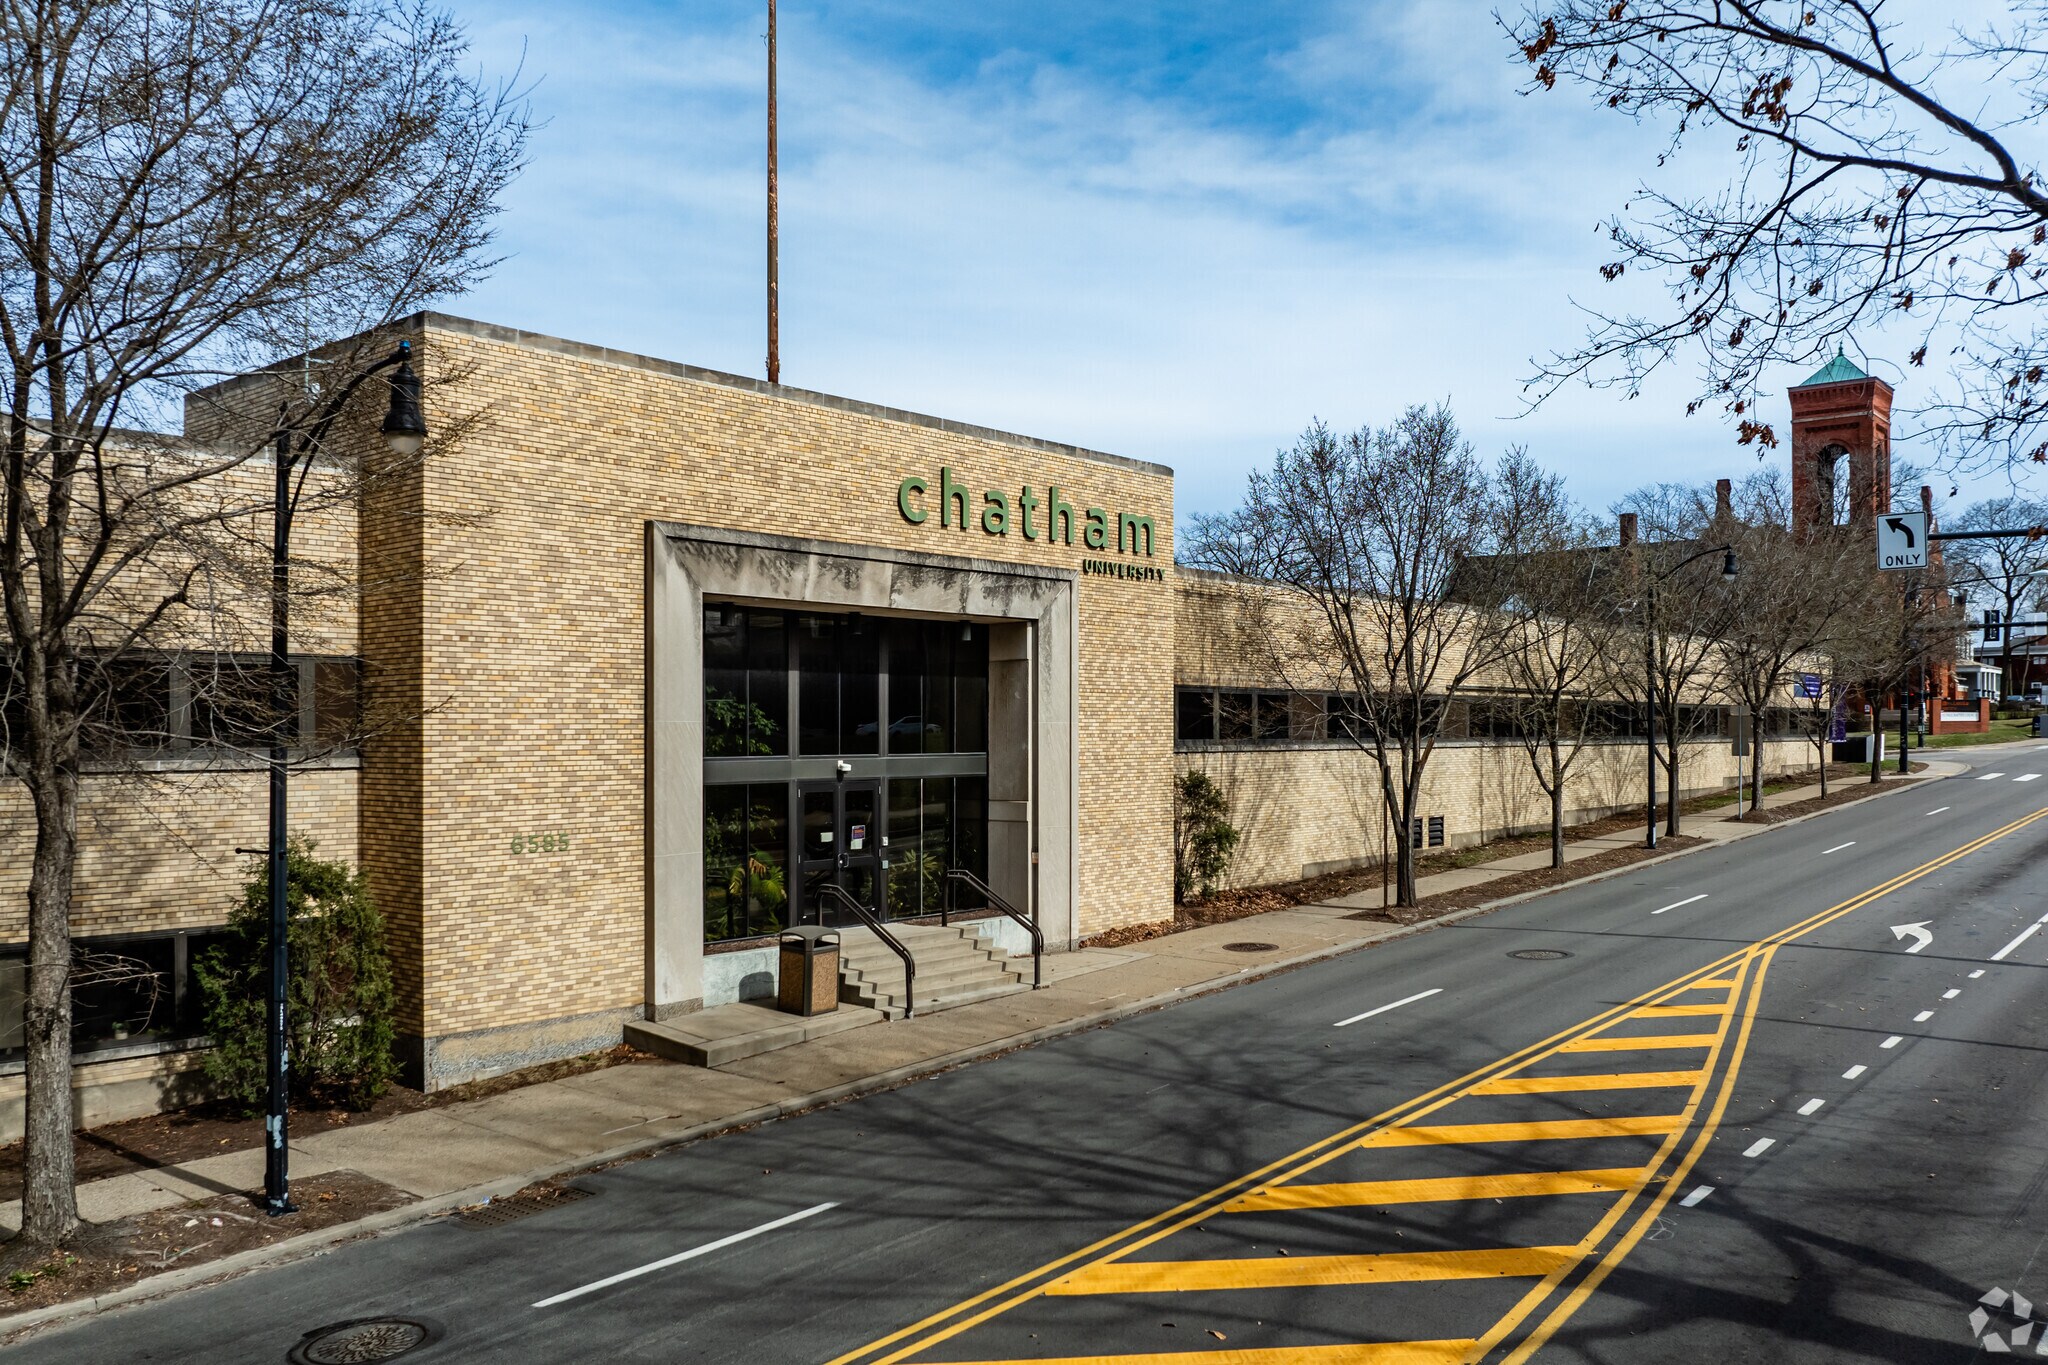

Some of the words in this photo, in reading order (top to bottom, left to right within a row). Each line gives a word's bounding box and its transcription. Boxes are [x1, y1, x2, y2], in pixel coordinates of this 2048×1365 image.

[898, 466, 1155, 556] chatham
[1082, 559, 1166, 583] UNIVERSITY
[1885, 554, 1921, 567] ONLY
[511, 832, 570, 855] 6585
